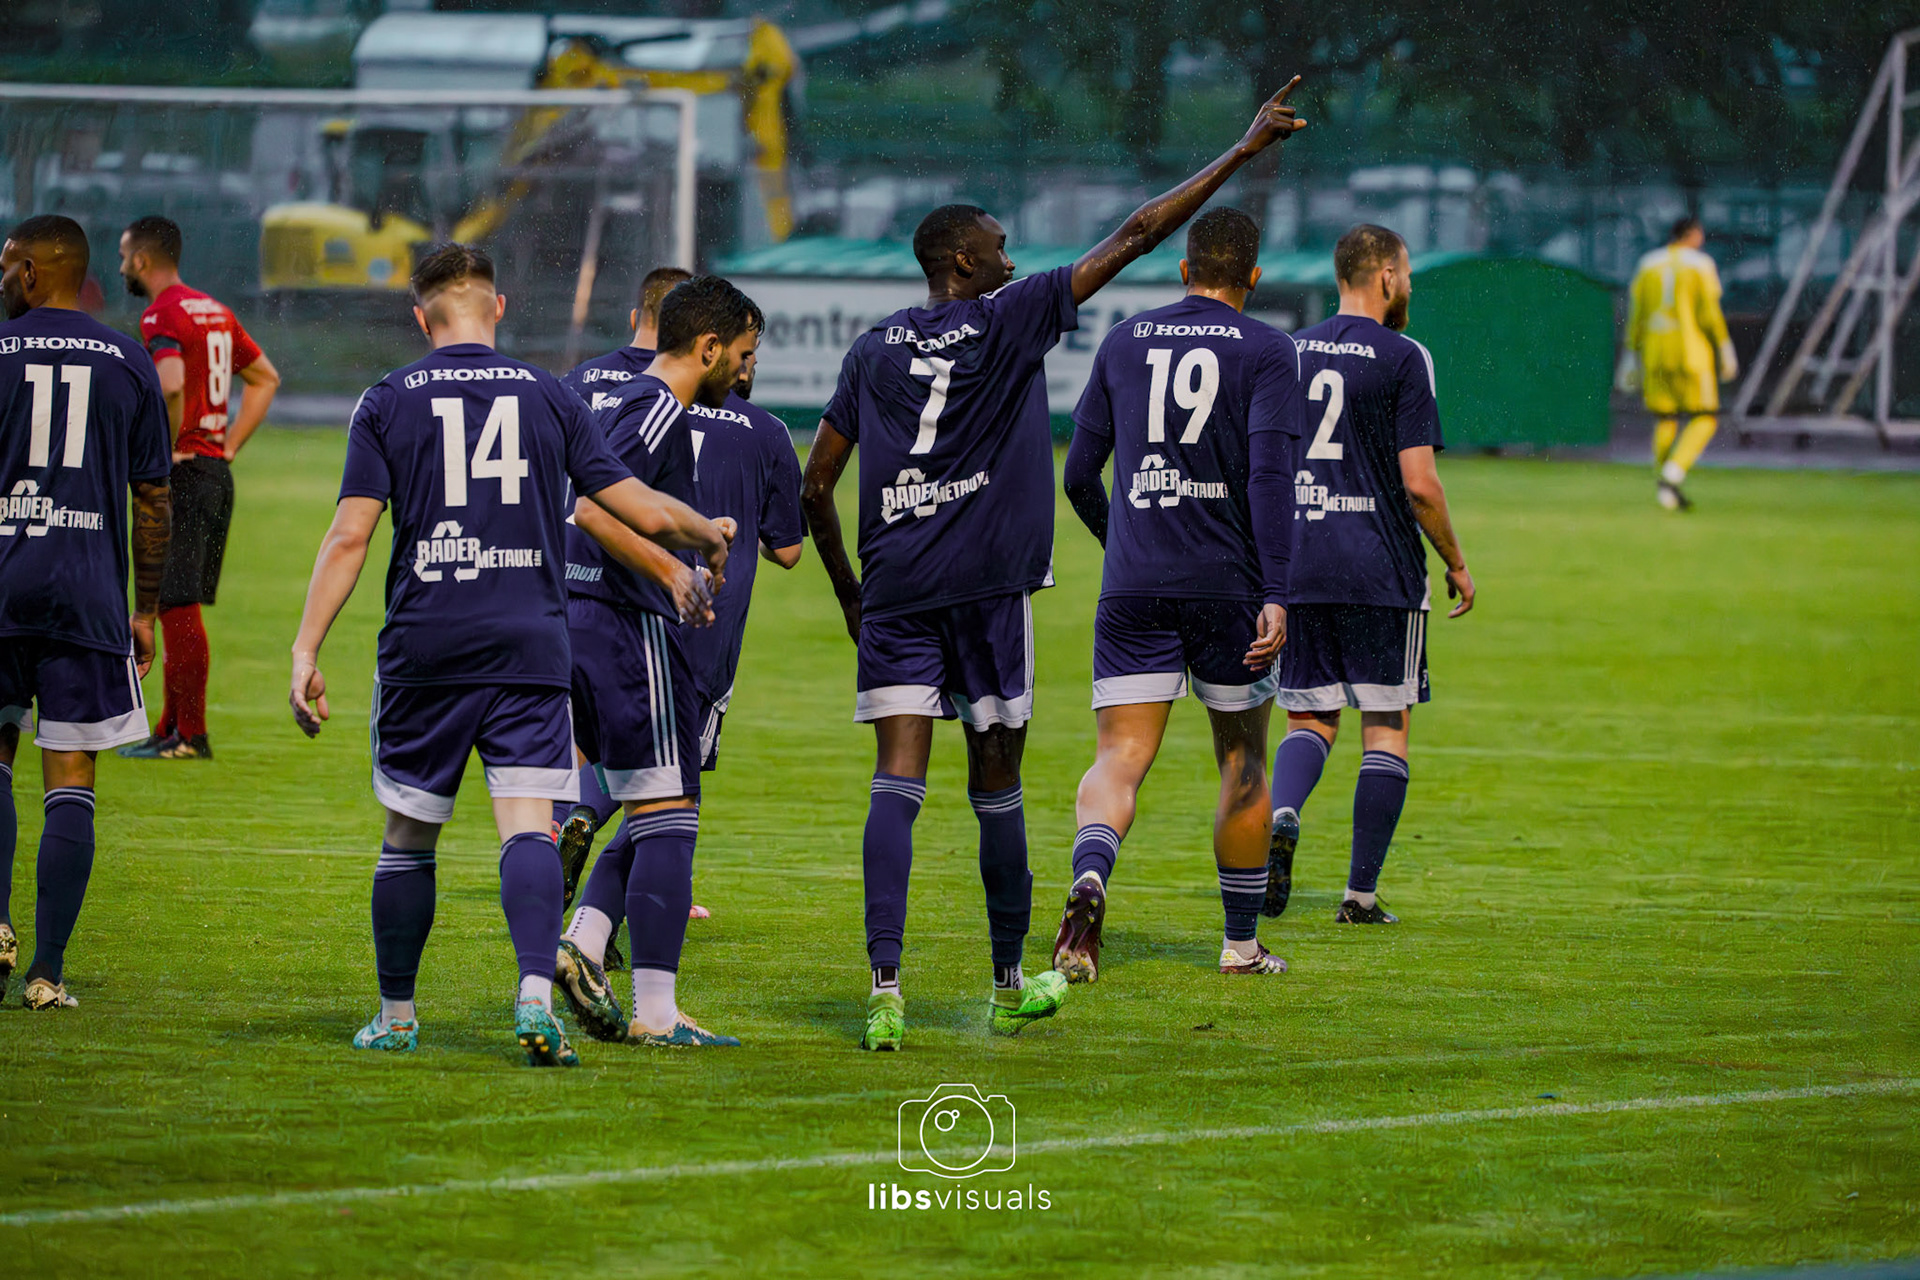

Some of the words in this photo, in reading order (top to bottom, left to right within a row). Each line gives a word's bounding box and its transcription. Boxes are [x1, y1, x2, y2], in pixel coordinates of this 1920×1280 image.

[1154, 324, 1243, 339] HONDA
[23, 337, 124, 359] HONDA
[1306, 339, 1376, 359] HONDA
[431, 367, 537, 382] HONDA
[909, 357, 956, 455] 7
[1145, 347, 1220, 444] 19
[25, 364, 92, 468] 11
[687, 403, 753, 430] ONDA
[1306, 369, 1344, 460] 2
[431, 396, 528, 507] 14
[1132, 468, 1180, 492] BADER
[1176, 478, 1225, 499] MÉTAUX
[1294, 485, 1328, 505] DER
[1322, 493, 1369, 512] MÉTAUX
[0, 496, 53, 519] BADER
[46, 506, 100, 530] MÉTAUX
[417, 537, 481, 564] BADER
[474, 546, 533, 569] MÉTAUX
[564, 562, 598, 582] TAUX
